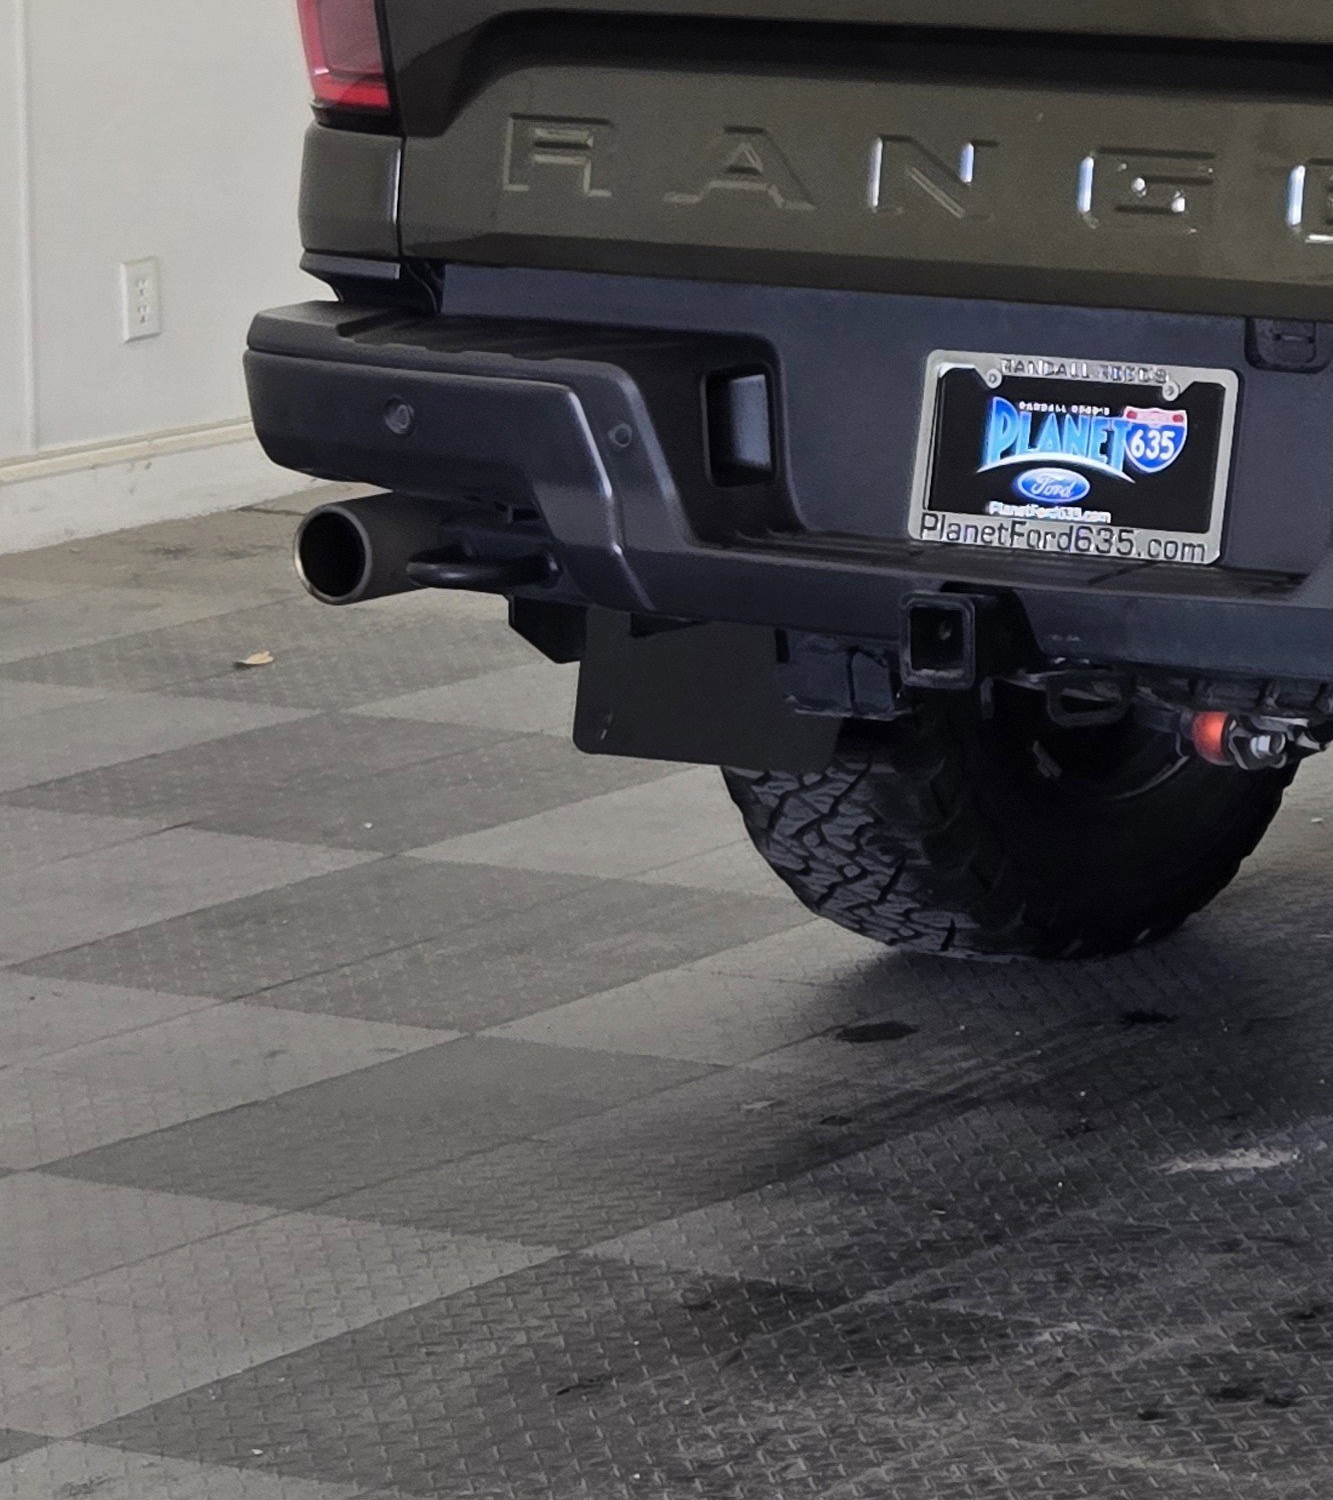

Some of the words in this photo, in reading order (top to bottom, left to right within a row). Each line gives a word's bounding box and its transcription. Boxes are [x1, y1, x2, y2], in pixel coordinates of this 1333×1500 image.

[986, 397, 1132, 473] PLANET
[1131, 428, 1176, 461] 635
[1030, 476, 1075, 498] Ford
[920, 513, 1206, 563] PlanetFord635.com
